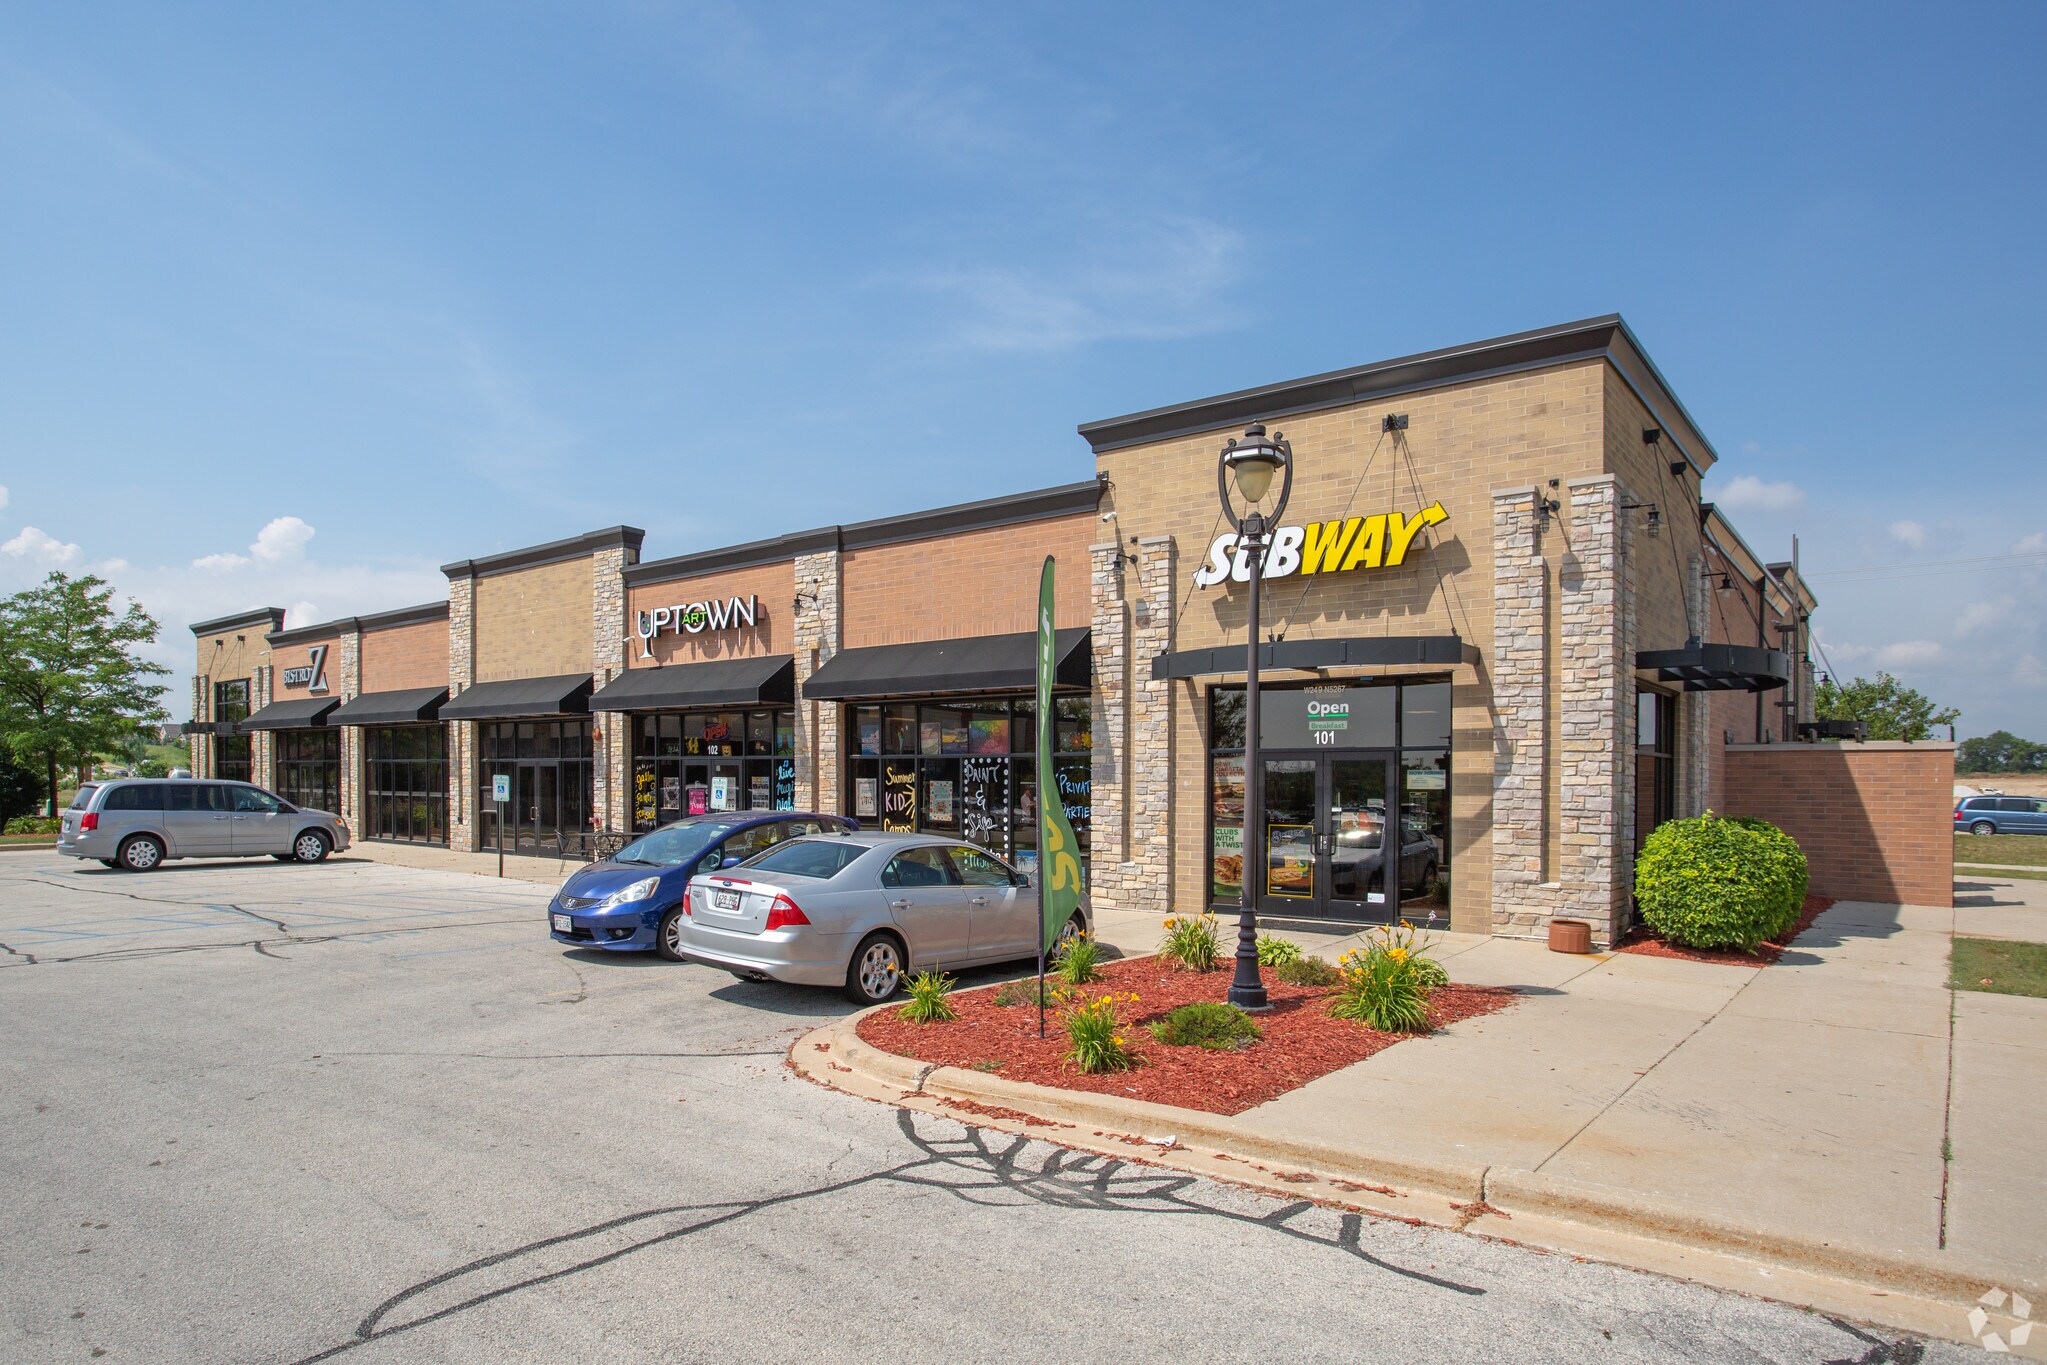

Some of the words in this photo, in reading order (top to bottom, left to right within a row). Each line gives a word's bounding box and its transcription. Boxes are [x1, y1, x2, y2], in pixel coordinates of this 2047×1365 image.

[1192, 500, 1449, 590] SUBWAY
[637, 594, 757, 657] UPTOWN
[681, 611, 708, 625] ART
[284, 667, 312, 685] BISTRO
[308, 645, 329, 691] Z
[1303, 686, 1323, 694] W249
[1307, 701, 1349, 717] Open
[1313, 730, 1336, 745] 101
[707, 744, 719, 755] 102
[885, 766, 916, 786] Summer
[1060, 774, 1091, 796] PRIVAT
